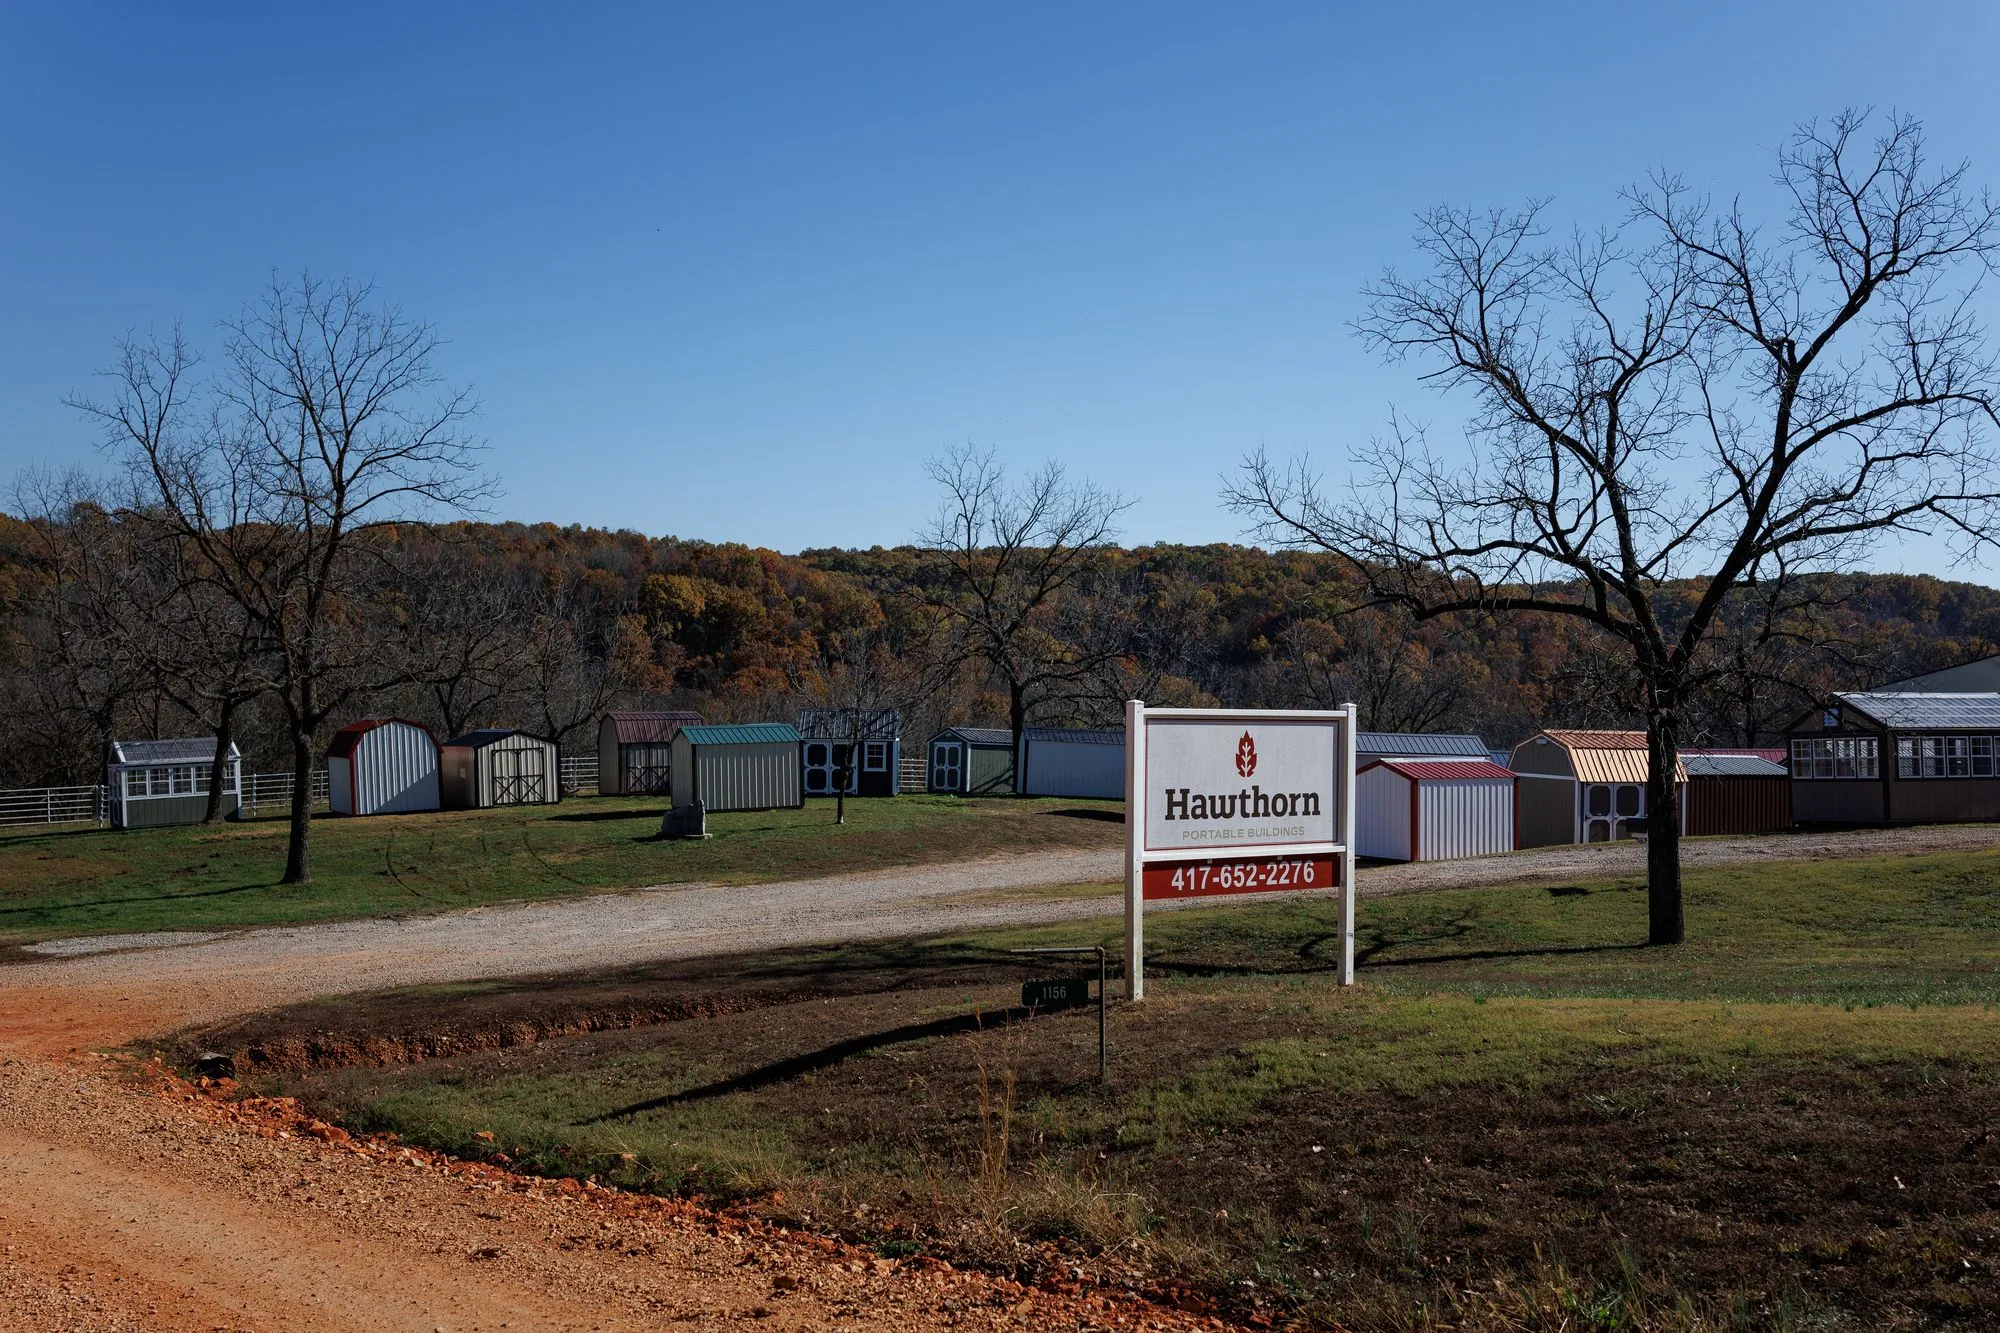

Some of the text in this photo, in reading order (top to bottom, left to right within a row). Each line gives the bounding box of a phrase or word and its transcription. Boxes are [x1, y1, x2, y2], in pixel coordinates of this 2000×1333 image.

[1165, 785, 1321, 821] Hawthorn
[1182, 826, 1305, 841] PORTABLE BUILDINGS
[1171, 859, 1315, 891] 417-652-2276
[1043, 985, 1067, 1000] 1156
